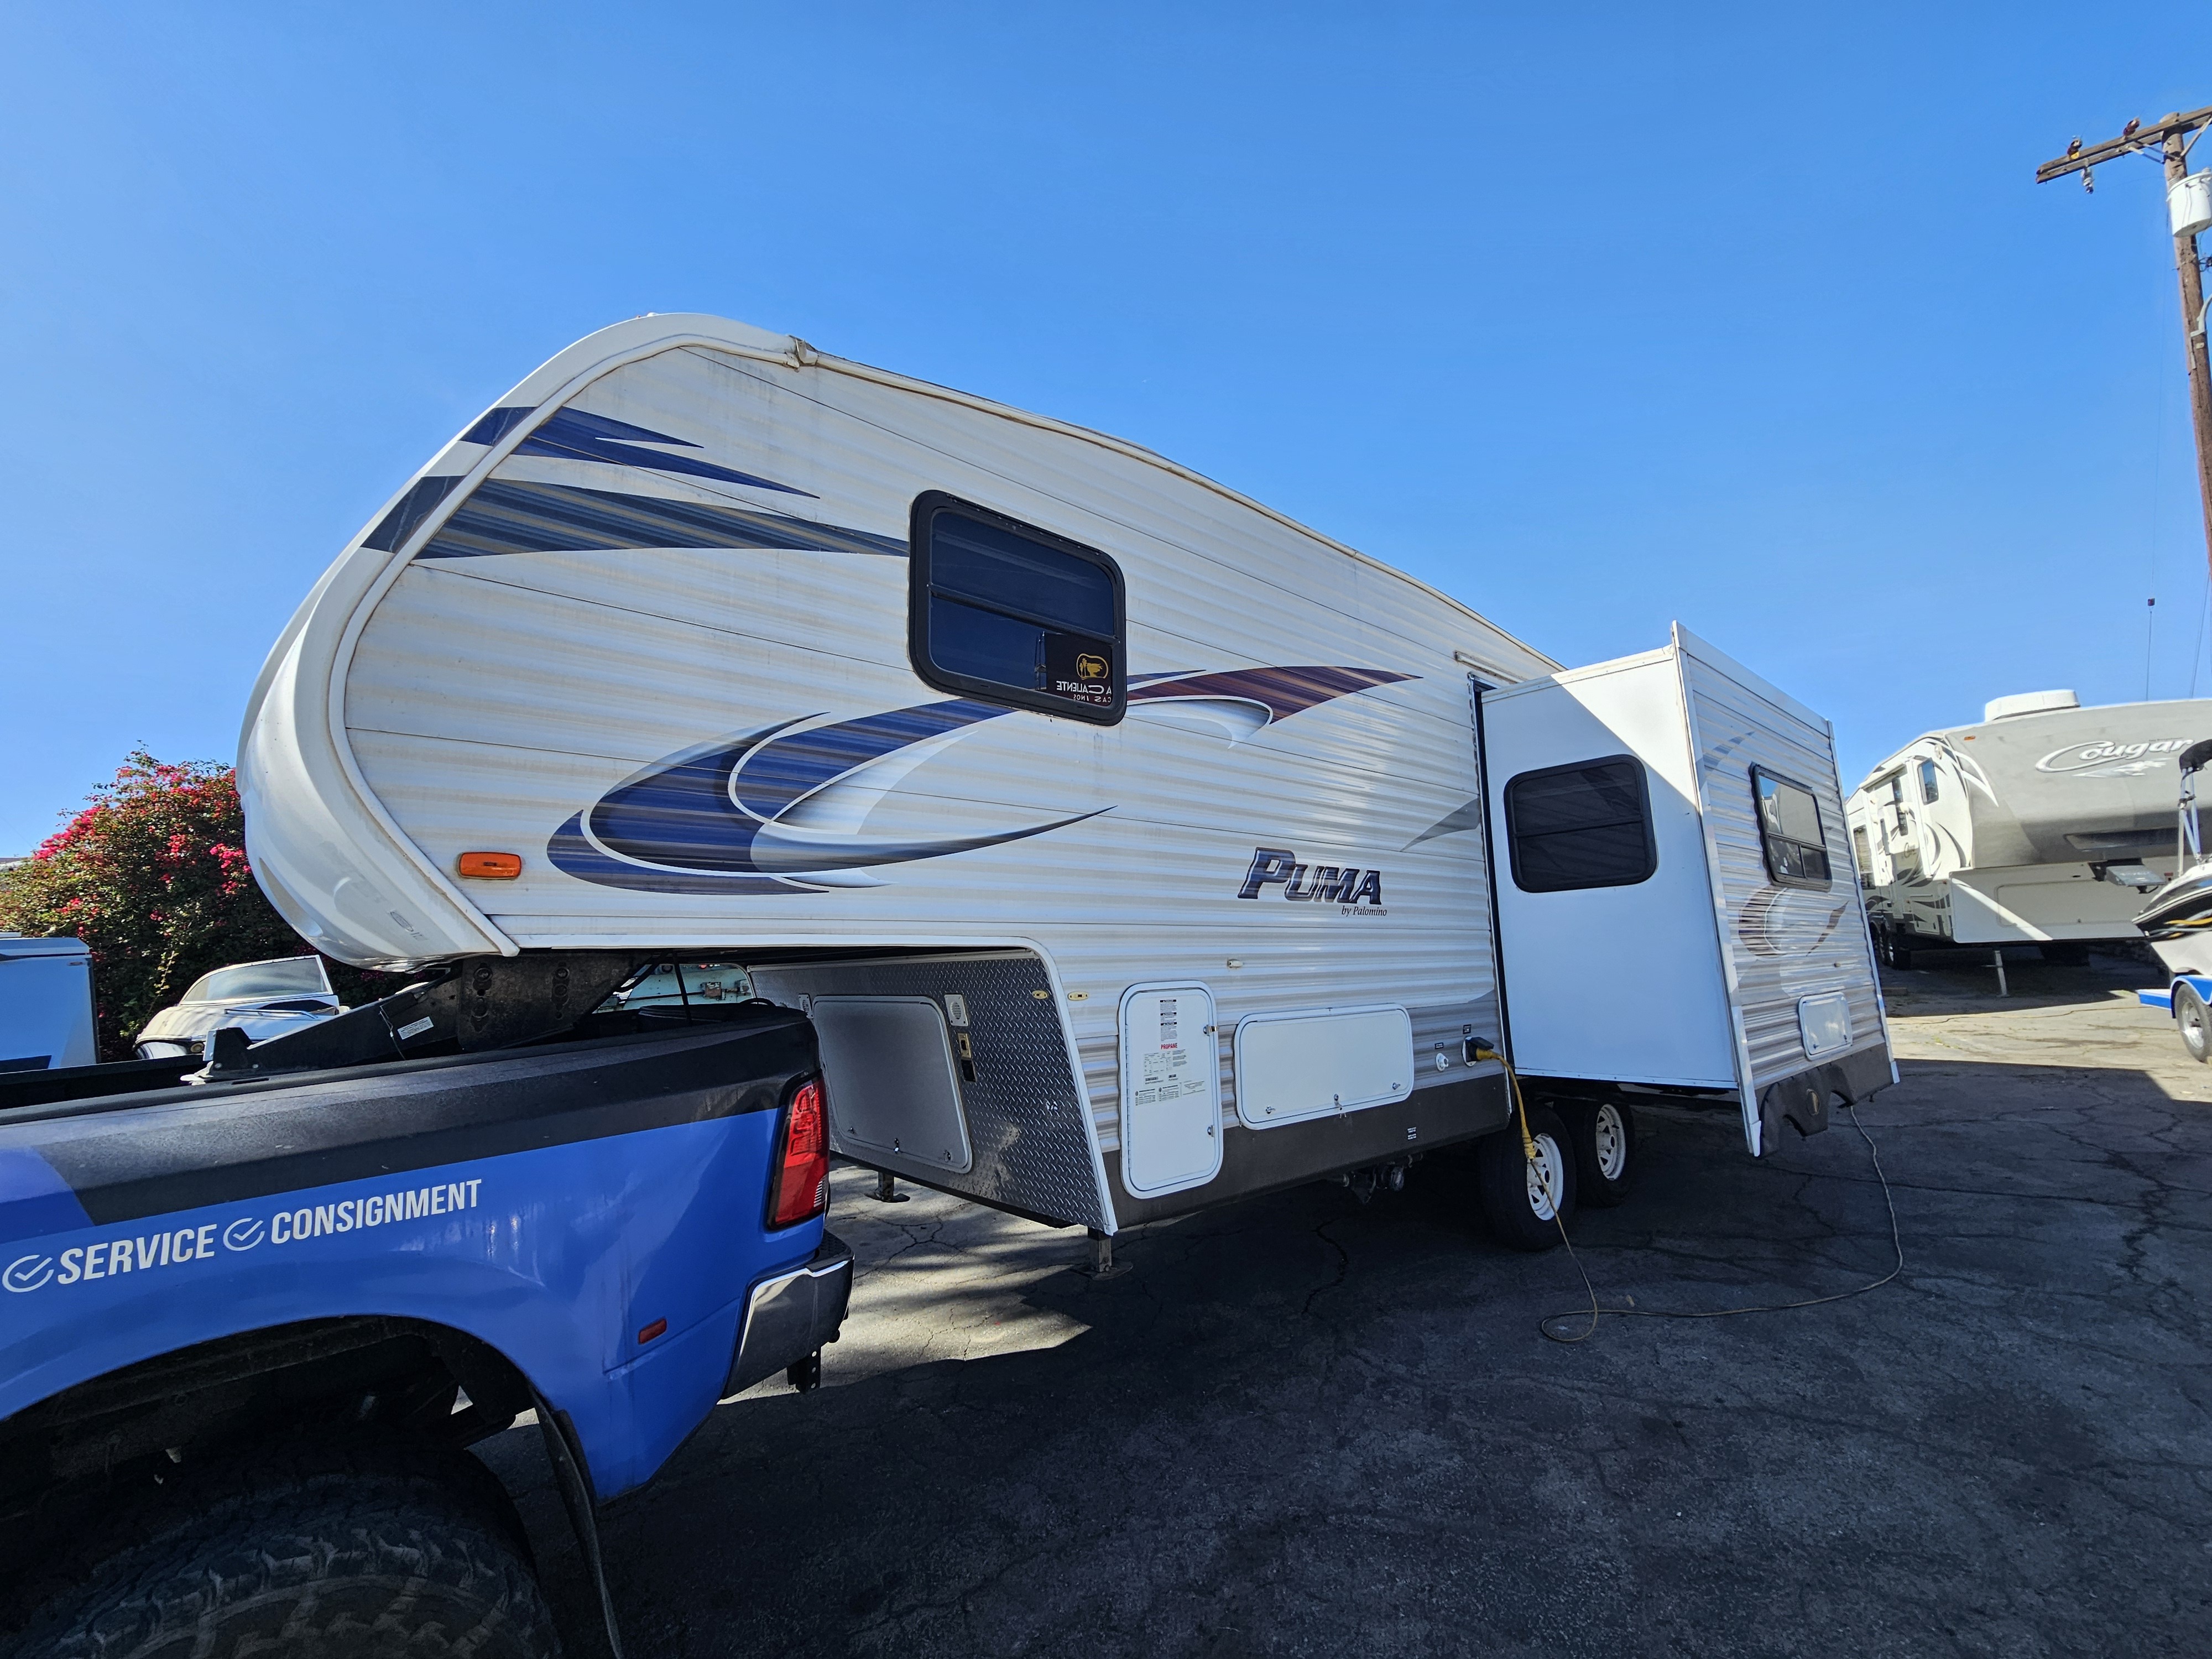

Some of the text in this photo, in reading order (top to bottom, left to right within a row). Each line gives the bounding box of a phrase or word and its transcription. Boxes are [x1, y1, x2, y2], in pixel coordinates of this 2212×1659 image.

[2036, 739, 2195, 773] Cougar
[1238, 847, 1381, 905] PUMA
[1342, 906, 1387, 917] by Palomino
[58, 1179, 482, 1285] SERVICE CONSIGNMENT
